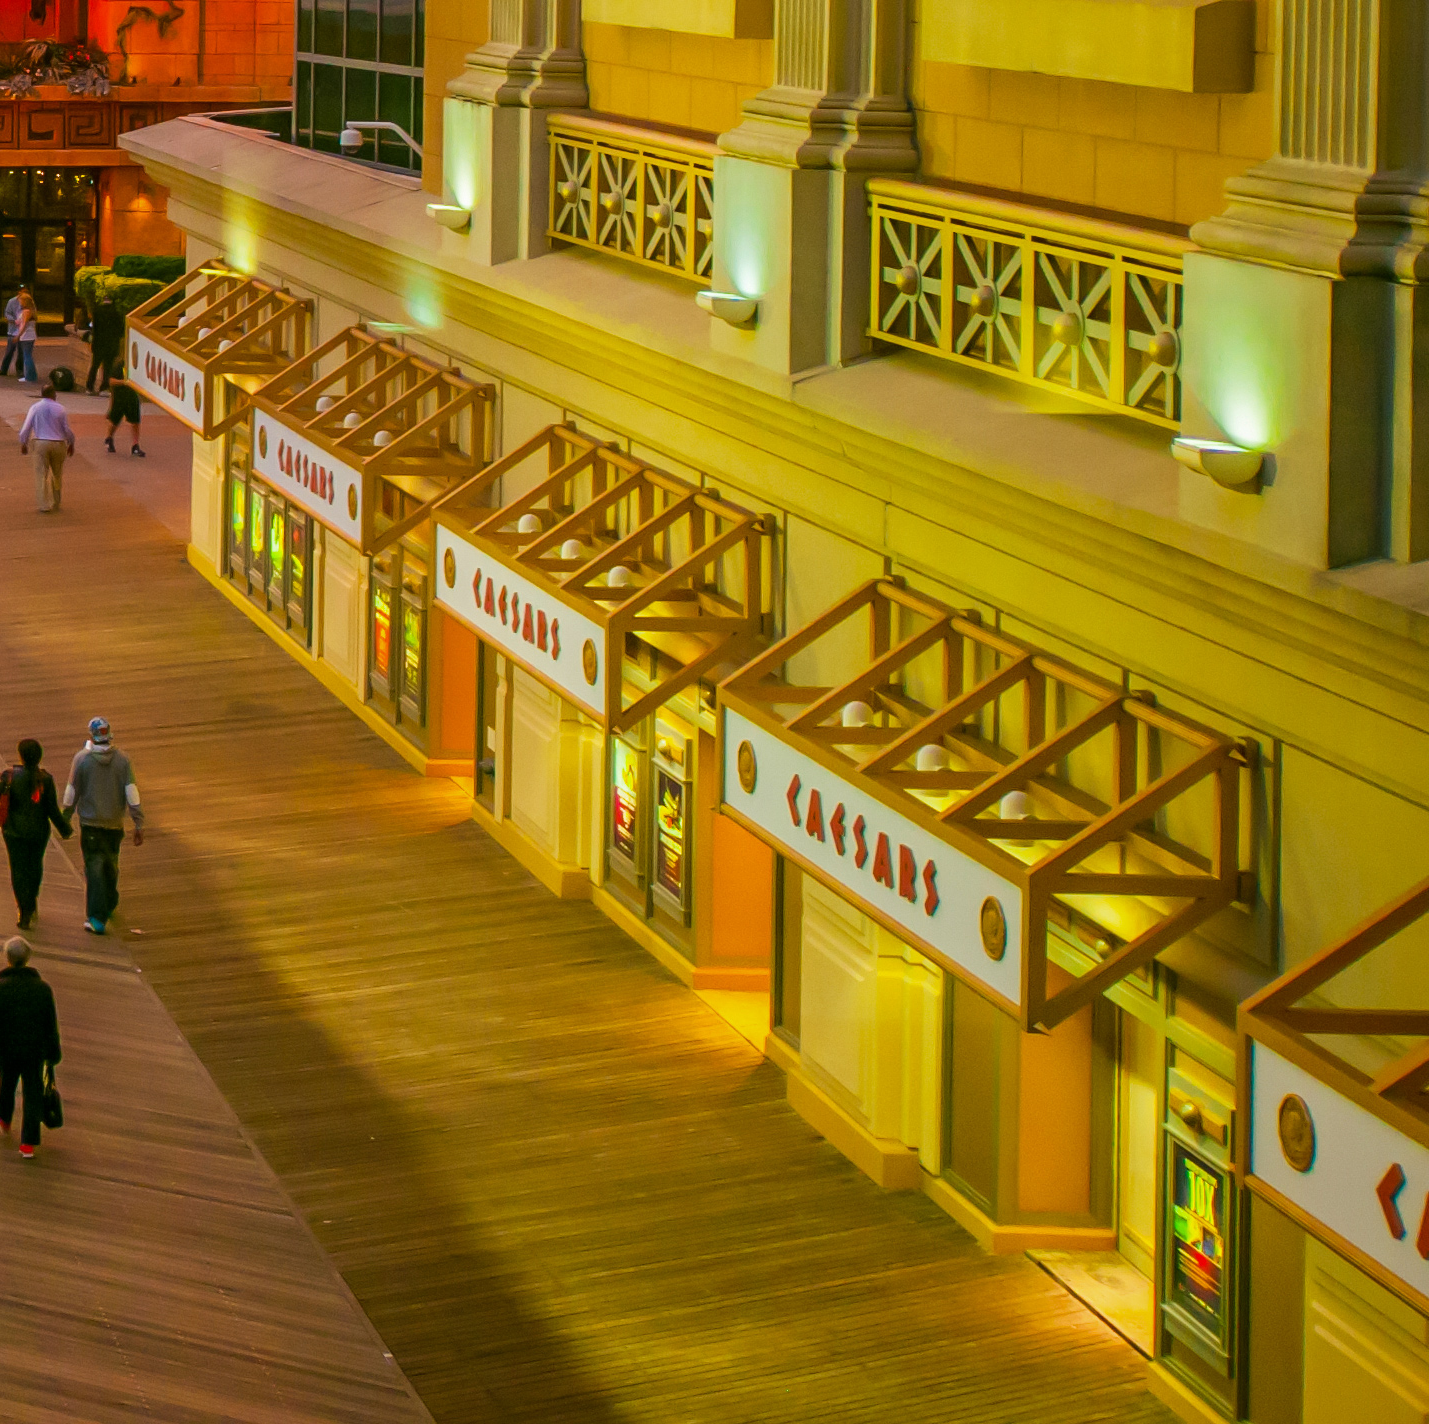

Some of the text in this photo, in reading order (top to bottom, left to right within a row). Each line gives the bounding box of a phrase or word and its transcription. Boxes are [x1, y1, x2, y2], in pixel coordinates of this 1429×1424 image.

[145, 351, 185, 402] CAESARS
[278, 439, 334, 505] CAESARS
[473, 568, 561, 661] CAESARS
[787, 774, 940, 917] CAESARS
[1186, 1170, 1215, 1228] 10X
